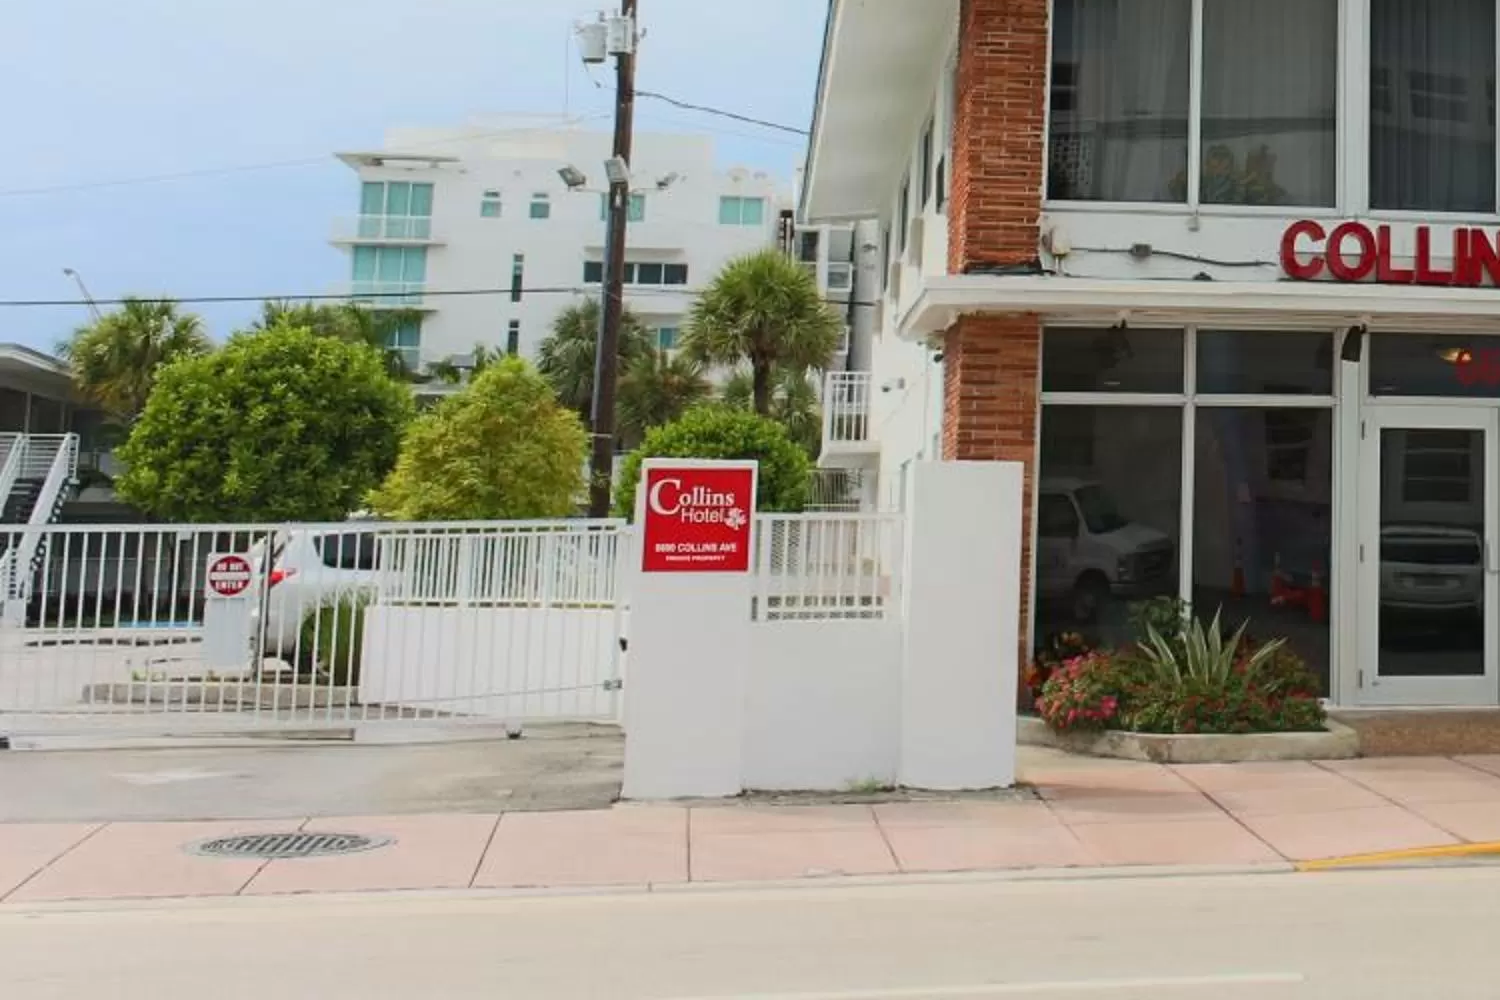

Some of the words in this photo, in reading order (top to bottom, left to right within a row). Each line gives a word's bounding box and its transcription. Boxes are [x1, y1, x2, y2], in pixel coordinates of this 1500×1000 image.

[649, 478, 735, 515] Collins
[681, 507, 724, 523] Hotel
[677, 543, 717, 552] COLLINS
[719, 543, 737, 552] AVE
[215, 581, 243, 590] ENTER
